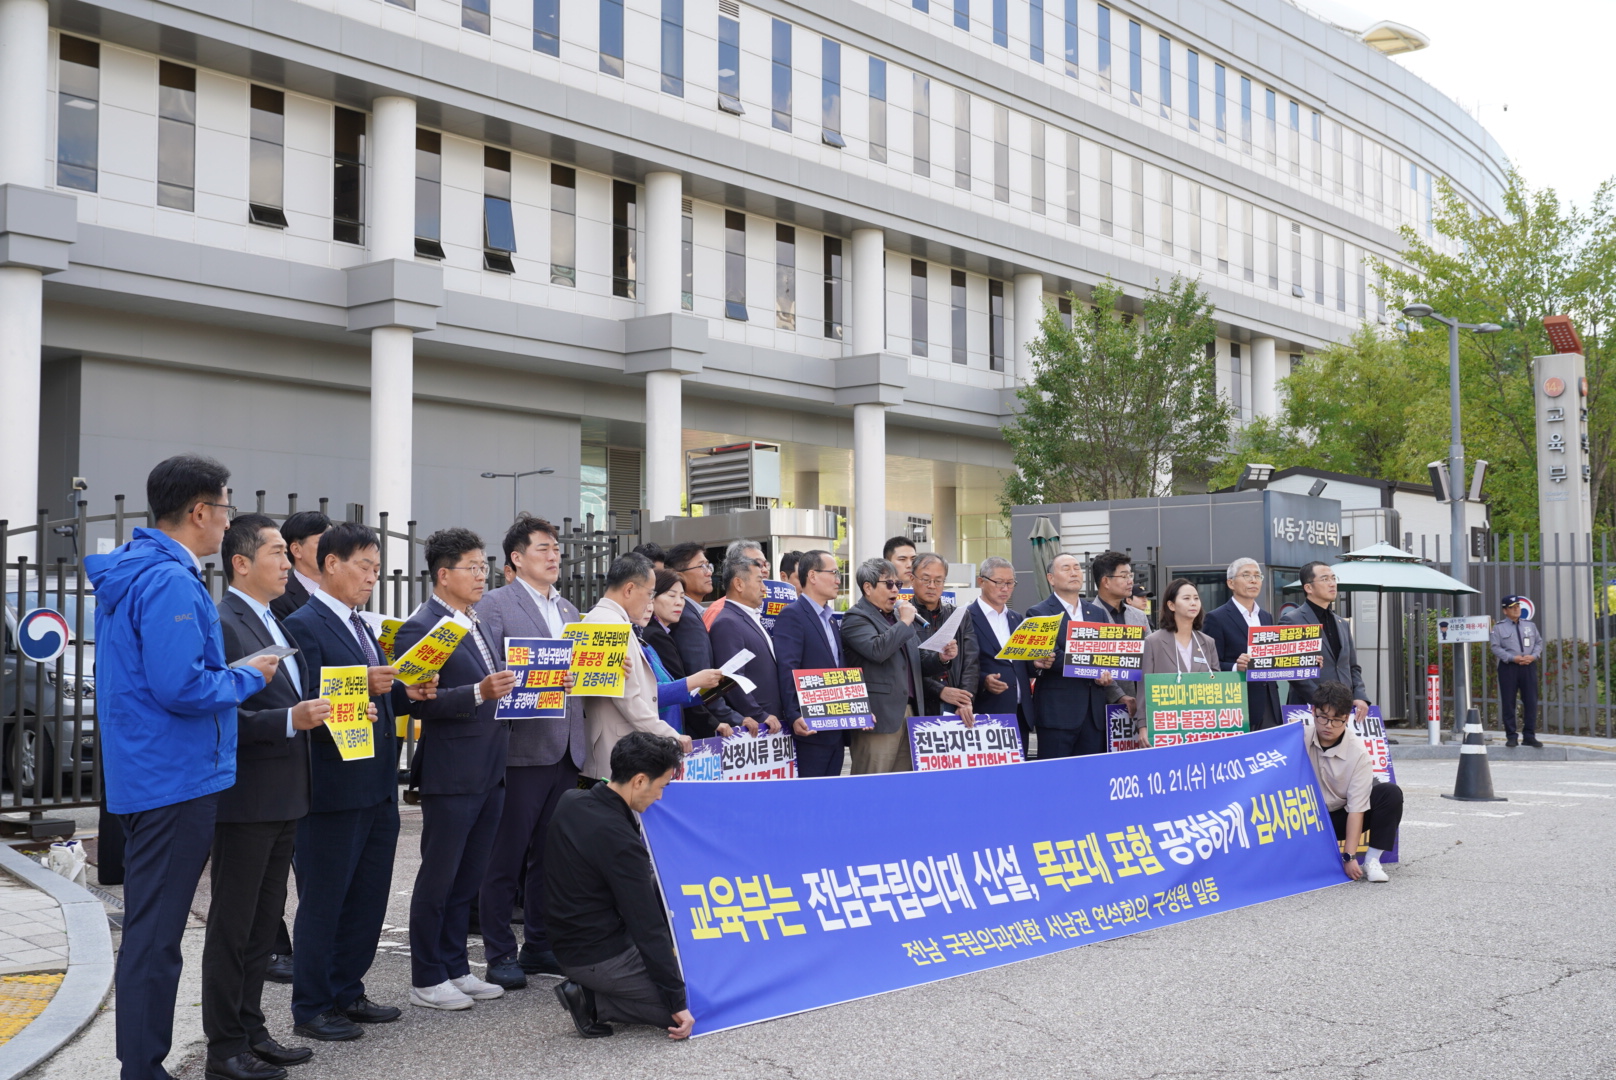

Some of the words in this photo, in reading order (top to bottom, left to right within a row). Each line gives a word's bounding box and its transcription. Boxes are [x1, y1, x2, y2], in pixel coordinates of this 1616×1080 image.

[1547, 408, 1567, 483] 교육부
[1273, 517, 1305, 542] 14동-2
[1306, 520, 1340, 547] 정문(북)
[592, 631, 630, 647] 전남국립의대
[1071, 627, 1098, 638] 교육부는
[1252, 631, 1279, 644] 교육부는
[1069, 641, 1116, 652] 전남국립의대
[1118, 641, 1141, 652] 추천안
[1251, 643, 1296, 658] 전남국립의대
[1298, 640, 1319, 652] 추천안
[508, 647, 535, 664] 교육부는
[538, 647, 572, 666] 전남국립의대
[1072, 654, 1090, 664] 전면
[1092, 654, 1140, 668] 재검토하라!
[1254, 658, 1272, 668] 전면
[513, 670, 524, 687] 설,
[527, 670, 551, 686] 목포대
[582, 672, 620, 687] 검증하라!
[798, 675, 824, 688] 교육부는
[1074, 668, 1098, 676] 국회의원
[322, 678, 343, 697] 교육부는
[801, 687, 844, 704] 전남국립의대
[844, 685, 865, 698] 추천안
[1151, 683, 1222, 706] 목포의대·대학병원
[1225, 682, 1242, 704] 신설
[807, 705, 825, 716] 전면
[826, 702, 869, 714] 재검토하라!
[1154, 710, 1216, 730] 불법·불공정
[1219, 709, 1243, 728] 심사
[345, 726, 370, 748] 검증하라!
[916, 730, 982, 754] 전남지역
[986, 728, 1018, 750] 의대
[723, 739, 769, 770] 신청서류
[772, 735, 794, 762] 일체
[1110, 776, 1144, 801] 2026.
[1147, 772, 1166, 795] 10.
[1169, 763, 1207, 792] 21.(수)
[1211, 759, 1245, 784] 14:00
[1246, 749, 1288, 775] 교육부
[681, 874, 807, 942] 교육부는
[802, 852, 977, 931] 전남국립의대
[973, 844, 1040, 905] 신설,
[1033, 832, 1114, 892] 목포대
[1105, 824, 1165, 878] 포함
[1153, 802, 1250, 865] 공정하게
[1250, 784, 1324, 845] 심사하라!
[901, 937, 947, 966] 전남
[942, 918, 1047, 958] 국립의과대학
[1049, 909, 1095, 939] 서남권
[1092, 895, 1153, 930] 연석회의
[1153, 884, 1194, 916] 구성원
[1192, 876, 1220, 907] 일동
